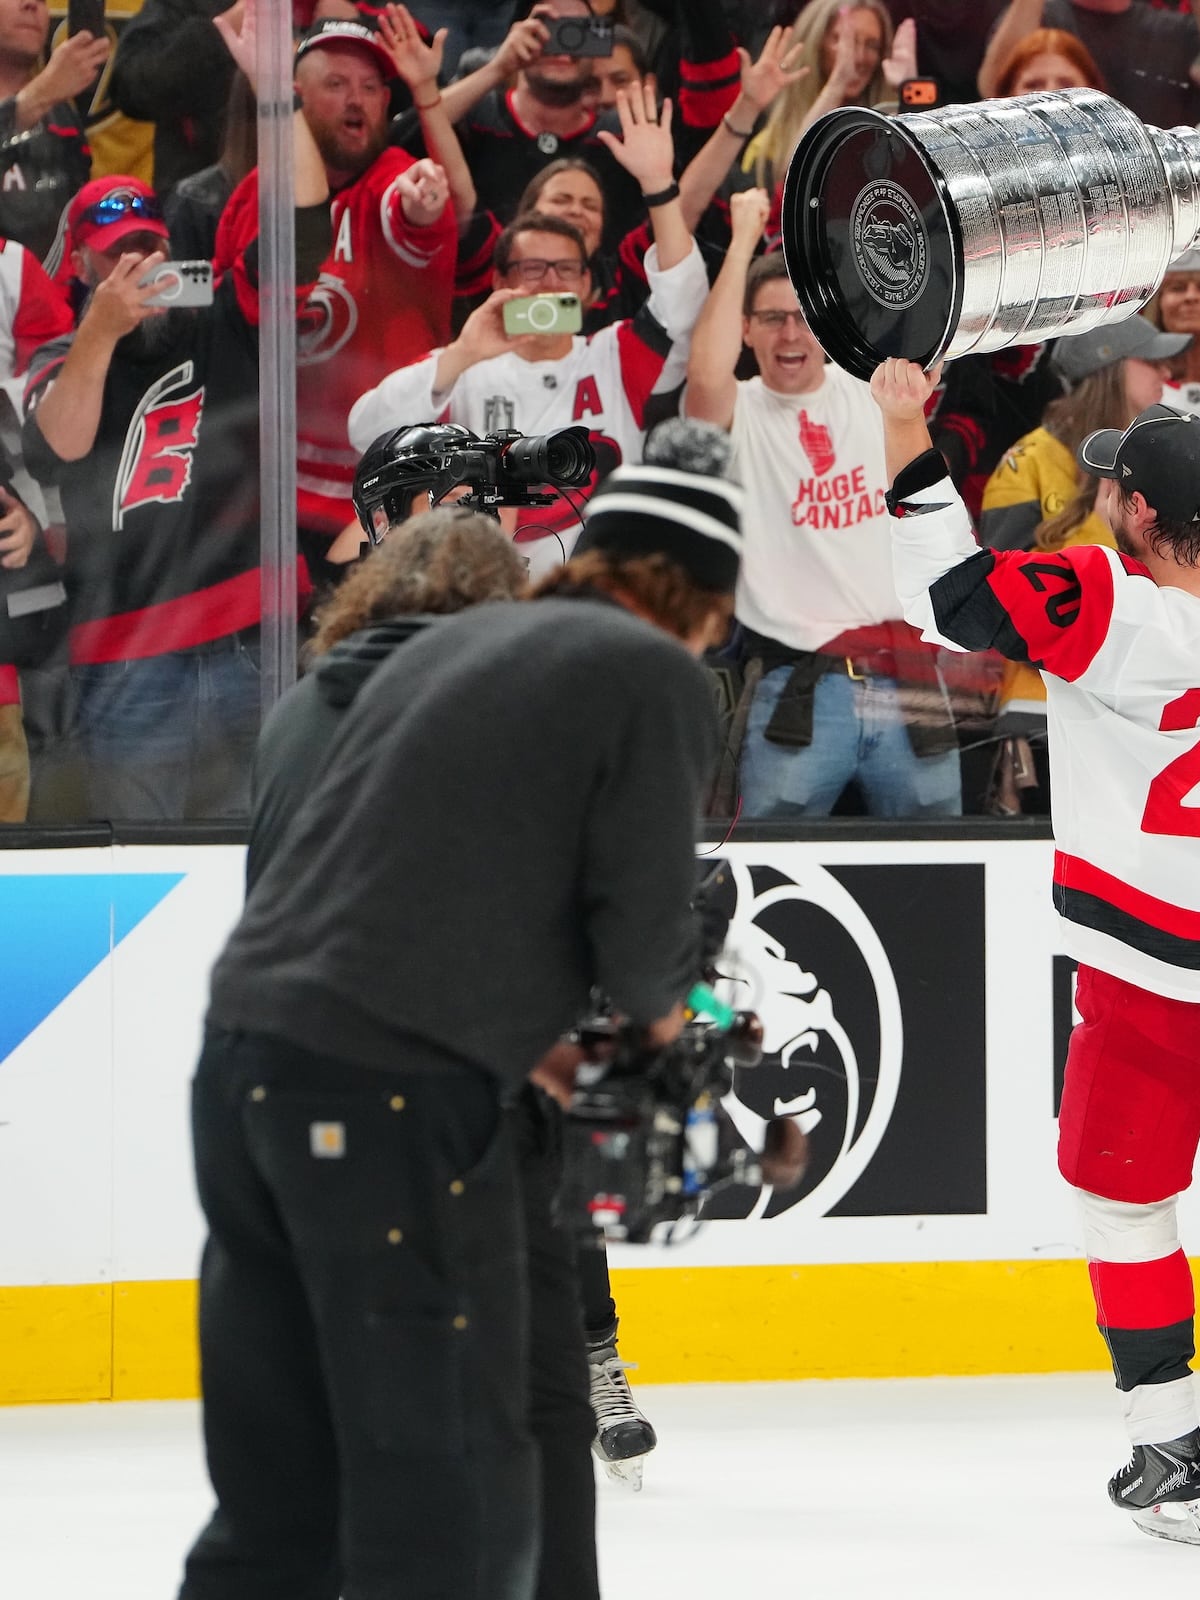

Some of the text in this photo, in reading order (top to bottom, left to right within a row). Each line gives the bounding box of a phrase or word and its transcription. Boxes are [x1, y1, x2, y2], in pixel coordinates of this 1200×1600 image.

[334, 207, 354, 263] A
[917, 231, 926, 273] HOCKEY
[908, 272, 923, 294] HALL
[572, 374, 604, 422] A
[798, 465, 866, 503] HUGE
